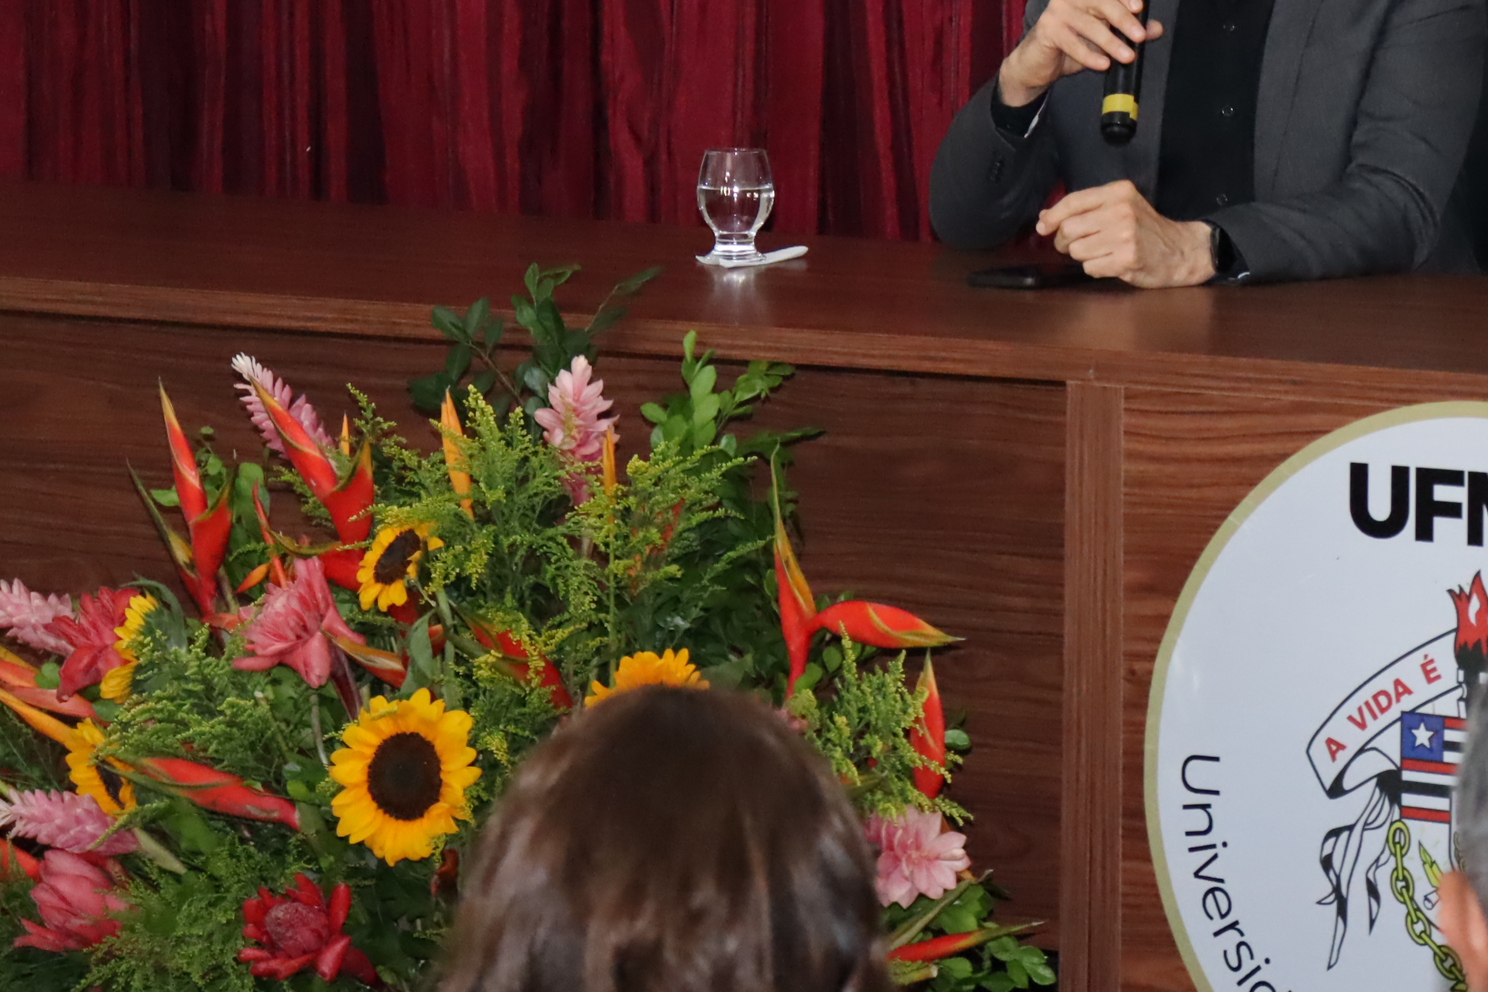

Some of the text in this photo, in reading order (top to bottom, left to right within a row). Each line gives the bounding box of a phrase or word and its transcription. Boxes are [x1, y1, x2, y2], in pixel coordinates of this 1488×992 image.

[1324, 654, 1443, 762] A VIDA É
